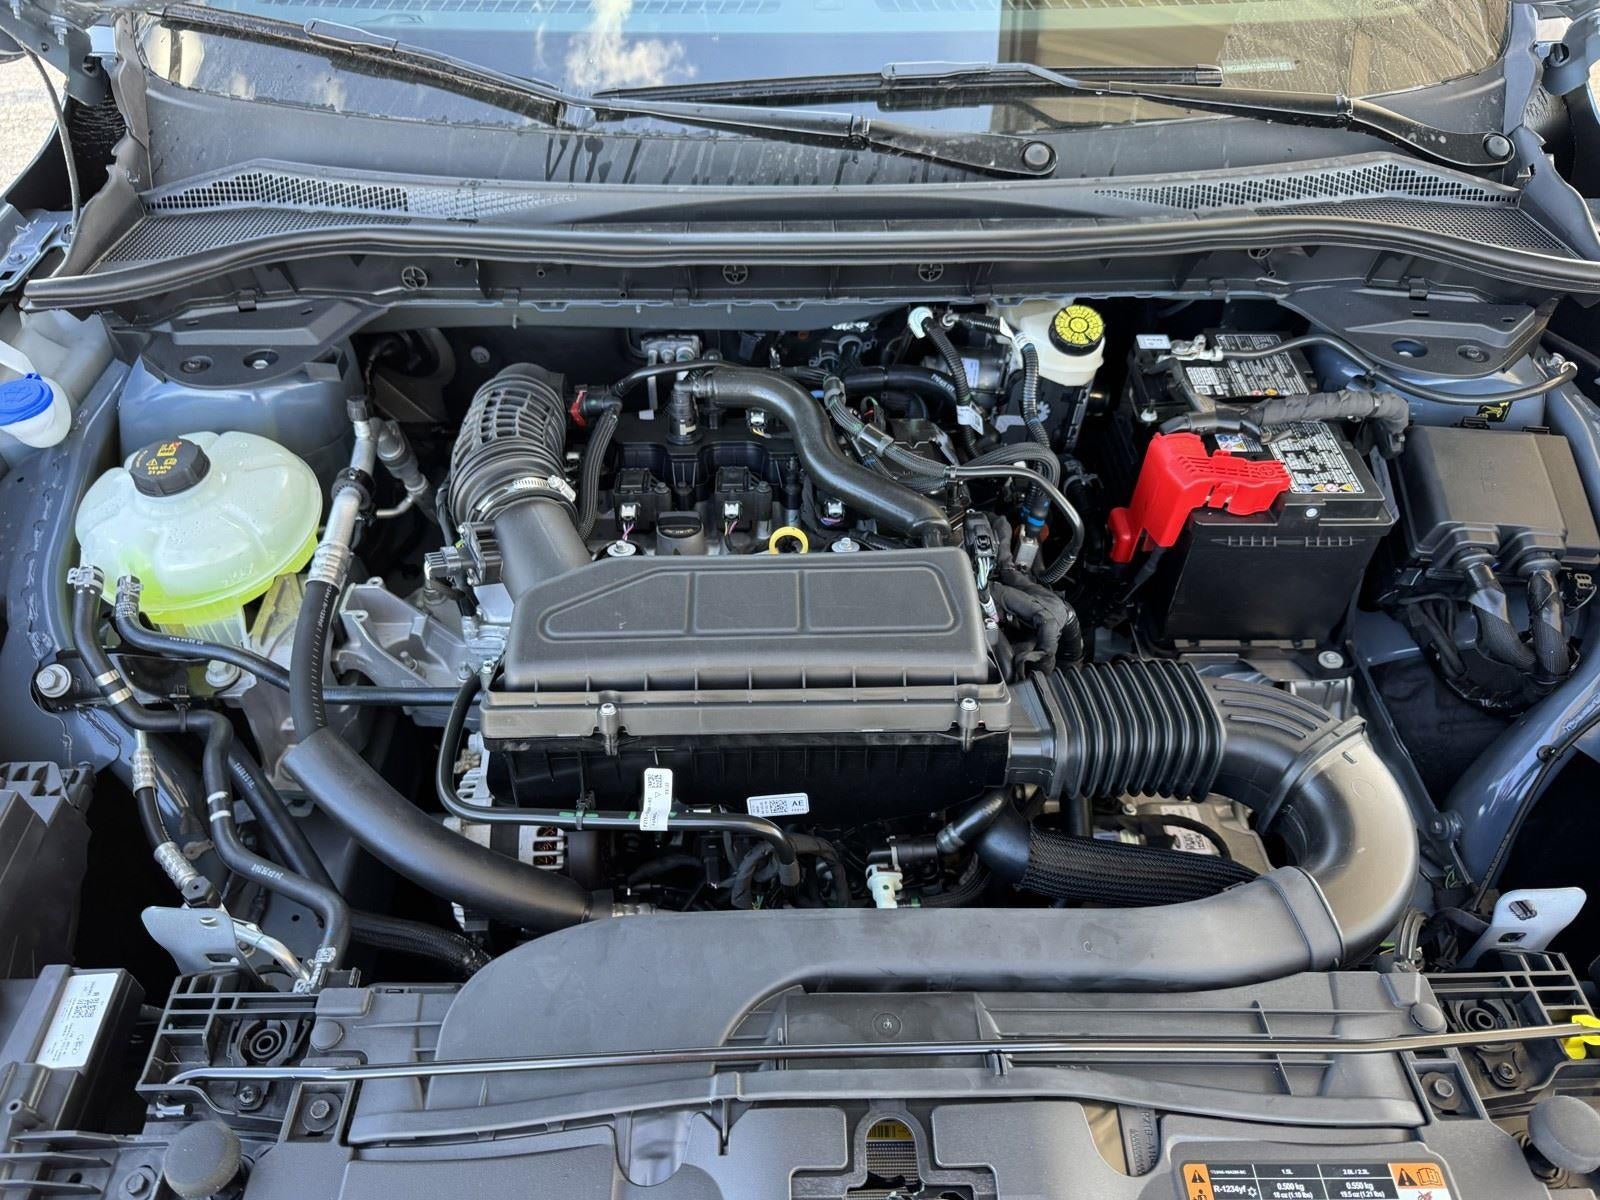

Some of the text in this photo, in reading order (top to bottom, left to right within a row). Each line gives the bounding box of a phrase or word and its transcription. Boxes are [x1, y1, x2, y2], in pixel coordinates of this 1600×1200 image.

[1280, 1168, 1294, 1176] 1.5L
[1213, 1185, 1247, 1194] R-1234yf
[1276, 1182, 1305, 1191] 0.500 kg
[1345, 1181, 1375, 1191] 0.550 kg
[1302, 1191, 1314, 1199] lbs)
[1340, 1190, 1352, 1198] 19.5
[1360, 1190, 1373, 1199] (1.21
[1373, 1190, 1386, 1199] lbs)
